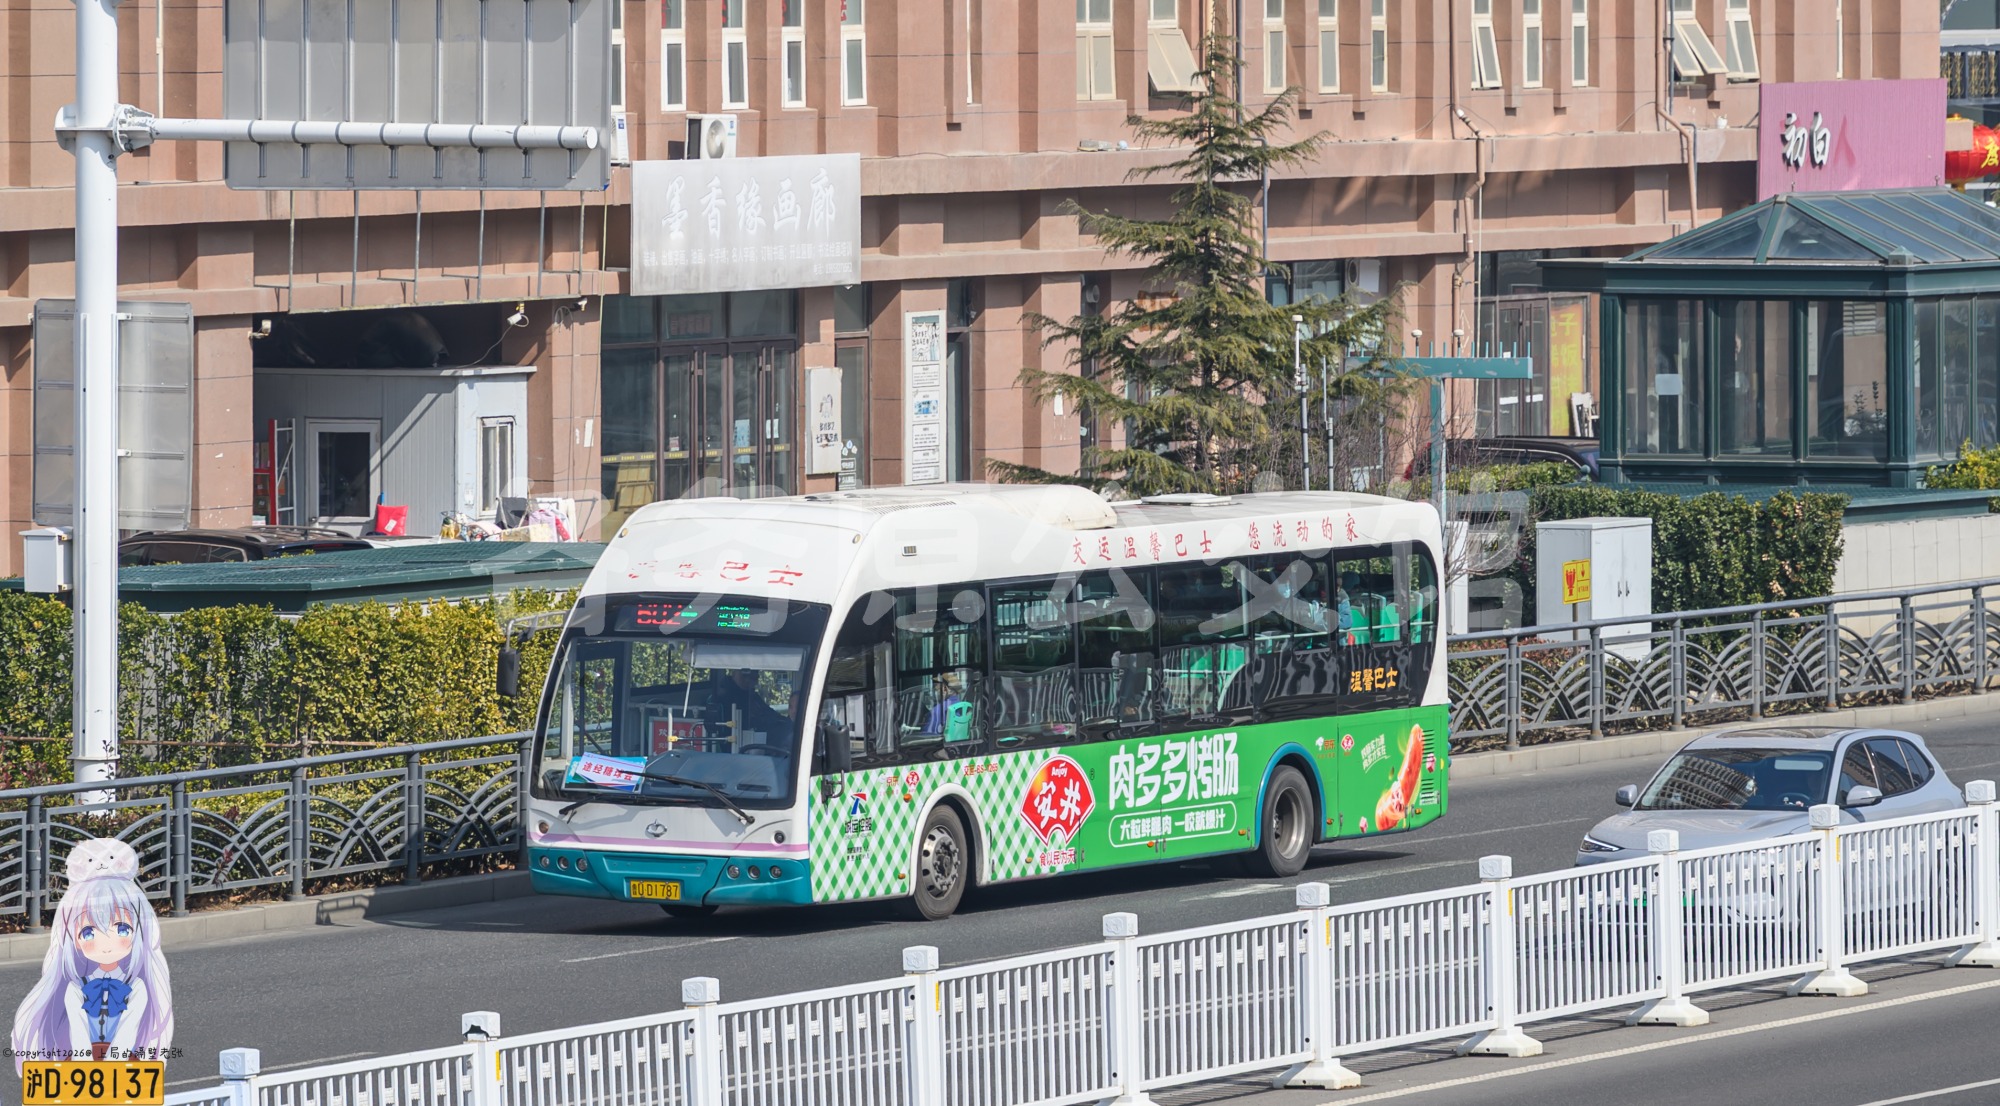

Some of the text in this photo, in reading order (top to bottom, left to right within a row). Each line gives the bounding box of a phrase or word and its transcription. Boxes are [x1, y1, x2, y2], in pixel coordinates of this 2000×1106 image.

[662, 167, 837, 240] 墨香缘画廊
[1072, 513, 1359, 565] 交运温馨巴士 您流动的家
[1350, 667, 1398, 692] 温馨巴士
[1051, 763, 1068, 777] Anjoy
[1109, 732, 1239, 811] 肉多多烤肠
[1033, 778, 1082, 829] 安井
[1039, 847, 1076, 867] 食以民为天
